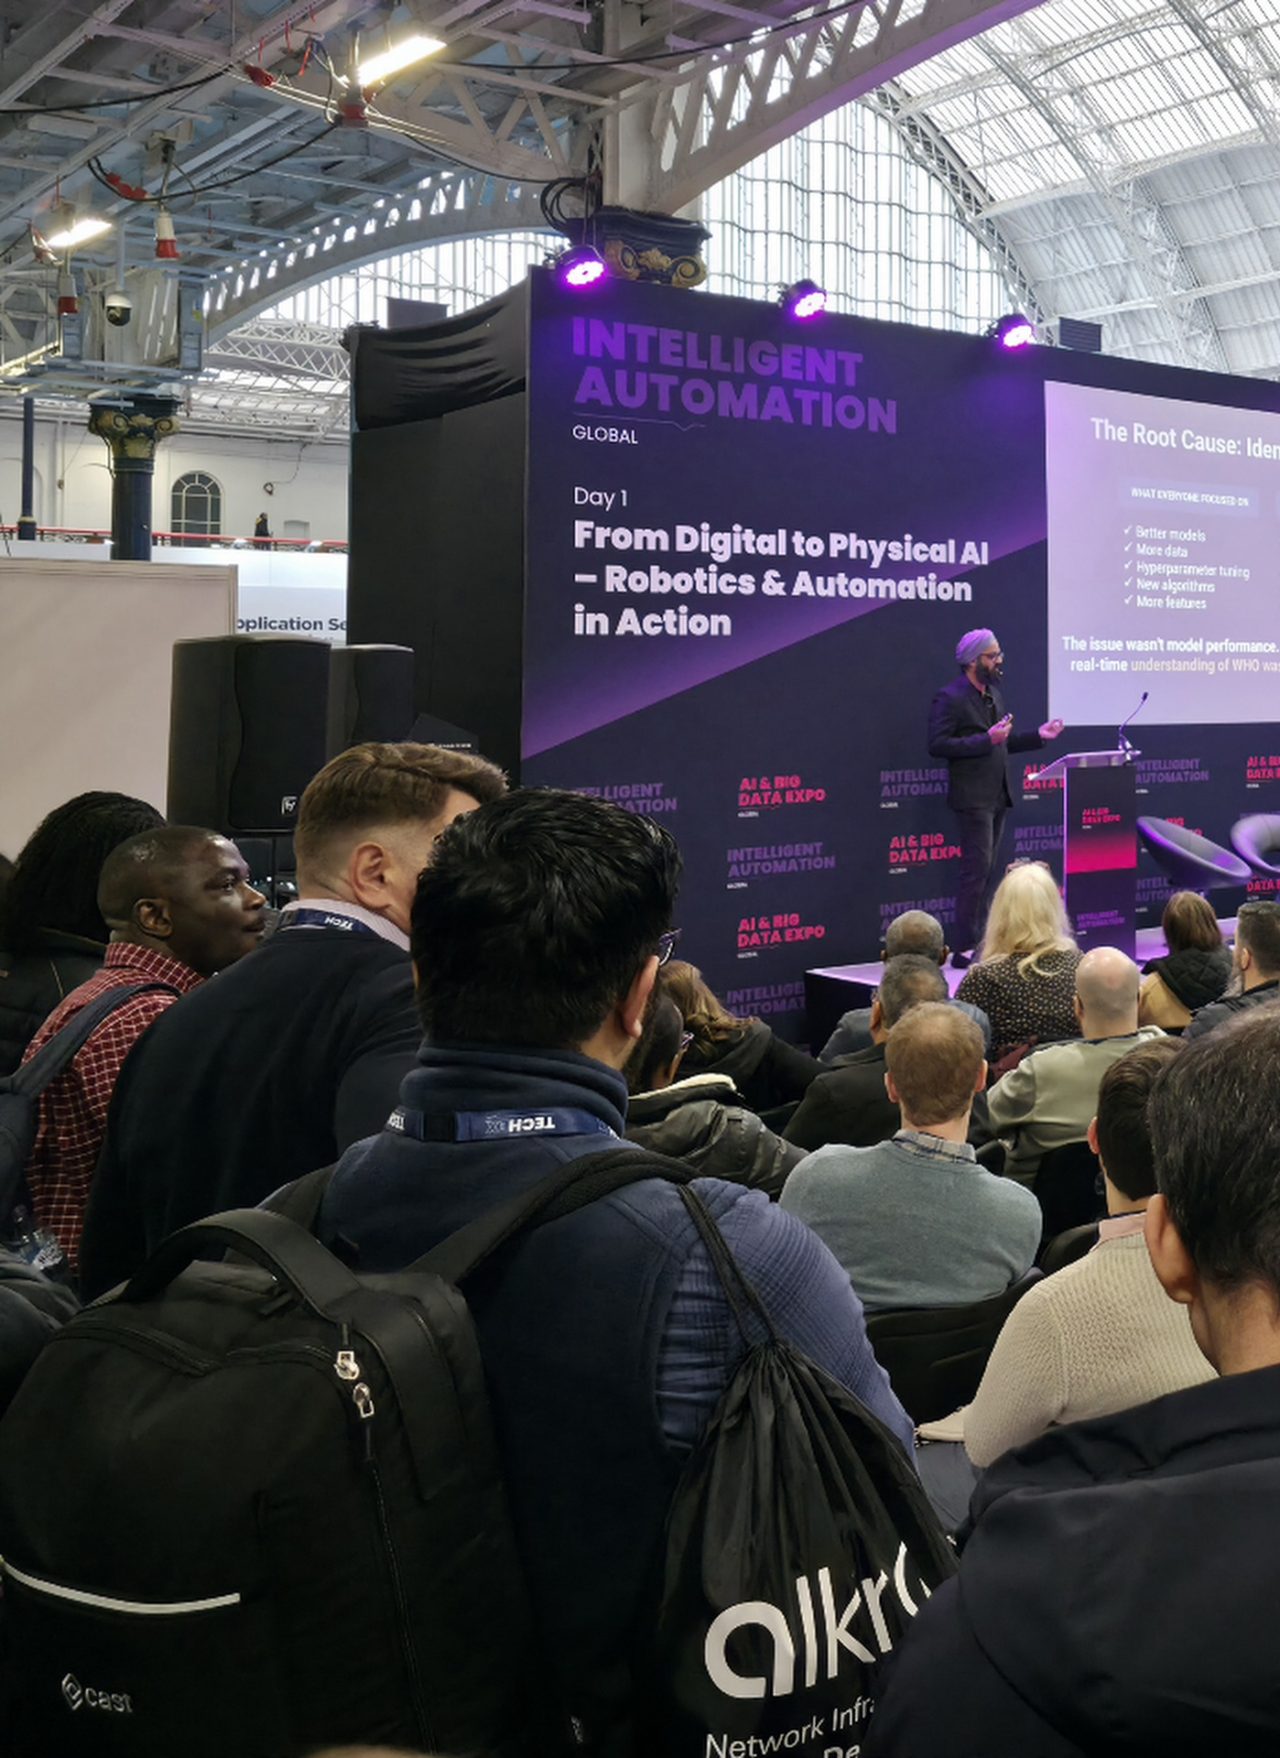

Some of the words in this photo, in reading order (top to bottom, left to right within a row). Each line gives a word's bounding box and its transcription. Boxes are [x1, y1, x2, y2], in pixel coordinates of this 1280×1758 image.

[572, 316, 863, 386] INTELLIGENT
[574, 366, 897, 434] AUTOMATION
[572, 425, 638, 444] GLOBAL
[1090, 417, 1127, 442] The
[1133, 424, 1176, 448] Root
[1182, 430, 1241, 455] Cause:
[575, 487, 615, 510] Day
[620, 490, 627, 507] 1
[1136, 525, 1166, 540] Better
[1170, 529, 1206, 542] models
[574, 520, 669, 552] From
[676, 522, 786, 562] Digital
[791, 531, 824, 557] to
[830, 532, 955, 568] Physical
[961, 541, 988, 565] AI
[1136, 543, 1162, 556] More
[1164, 544, 1188, 558] data
[1136, 560, 1217, 576] Hyperparameter
[1219, 567, 1250, 582] tuning
[605, 565, 755, 596] Robotics
[761, 570, 786, 596] &
[793, 572, 972, 602] Automation
[1136, 578, 1159, 591] New
[1162, 579, 1215, 594] algorithms
[1136, 596, 1163, 608] More
[1166, 595, 1206, 609] features
[574, 604, 609, 636] in
[616, 606, 731, 636] Action
[1062, 635, 1087, 651] The
[1090, 636, 1124, 652] issue
[1126, 637, 1164, 652] wasn't
[1166, 638, 1203, 652] model
[1206, 639, 1280, 655] performance.
[1070, 657, 1128, 672] real-time
[1130, 658, 1216, 675] understanding
[1218, 658, 1229, 672] of
[1232, 658, 1260, 672] WHO
[1136, 758, 1200, 771] NTELLIGENT
[740, 778, 757, 792] AI
[758, 777, 772, 790] &
[774, 774, 801, 789] BIG
[880, 768, 950, 784] INTELLIGE
[738, 791, 782, 806] DATA
[785, 788, 826, 802] EXPO
[880, 782, 948, 797] AUTOMAT
[890, 836, 906, 849] AI
[907, 835, 918, 848] &
[920, 833, 944, 846] BIG
[1014, 825, 1064, 840] INTELLIG
[727, 842, 823, 862] INTELLIGENT
[889, 849, 928, 864] DATA
[728, 856, 836, 878] AUTOMATION
[880, 897, 957, 916] INTELLIGEN
[324, 916, 353, 931] TECH
[738, 917, 756, 932] AI
[758, 916, 770, 930] &
[773, 913, 800, 928] BIG
[738, 930, 782, 948] DATA
[784, 925, 826, 942] EXPO
[727, 982, 805, 1004] INTELLIGE
[508, 1116, 556, 1133] TECH
[705, 1716, 824, 1758] Network
